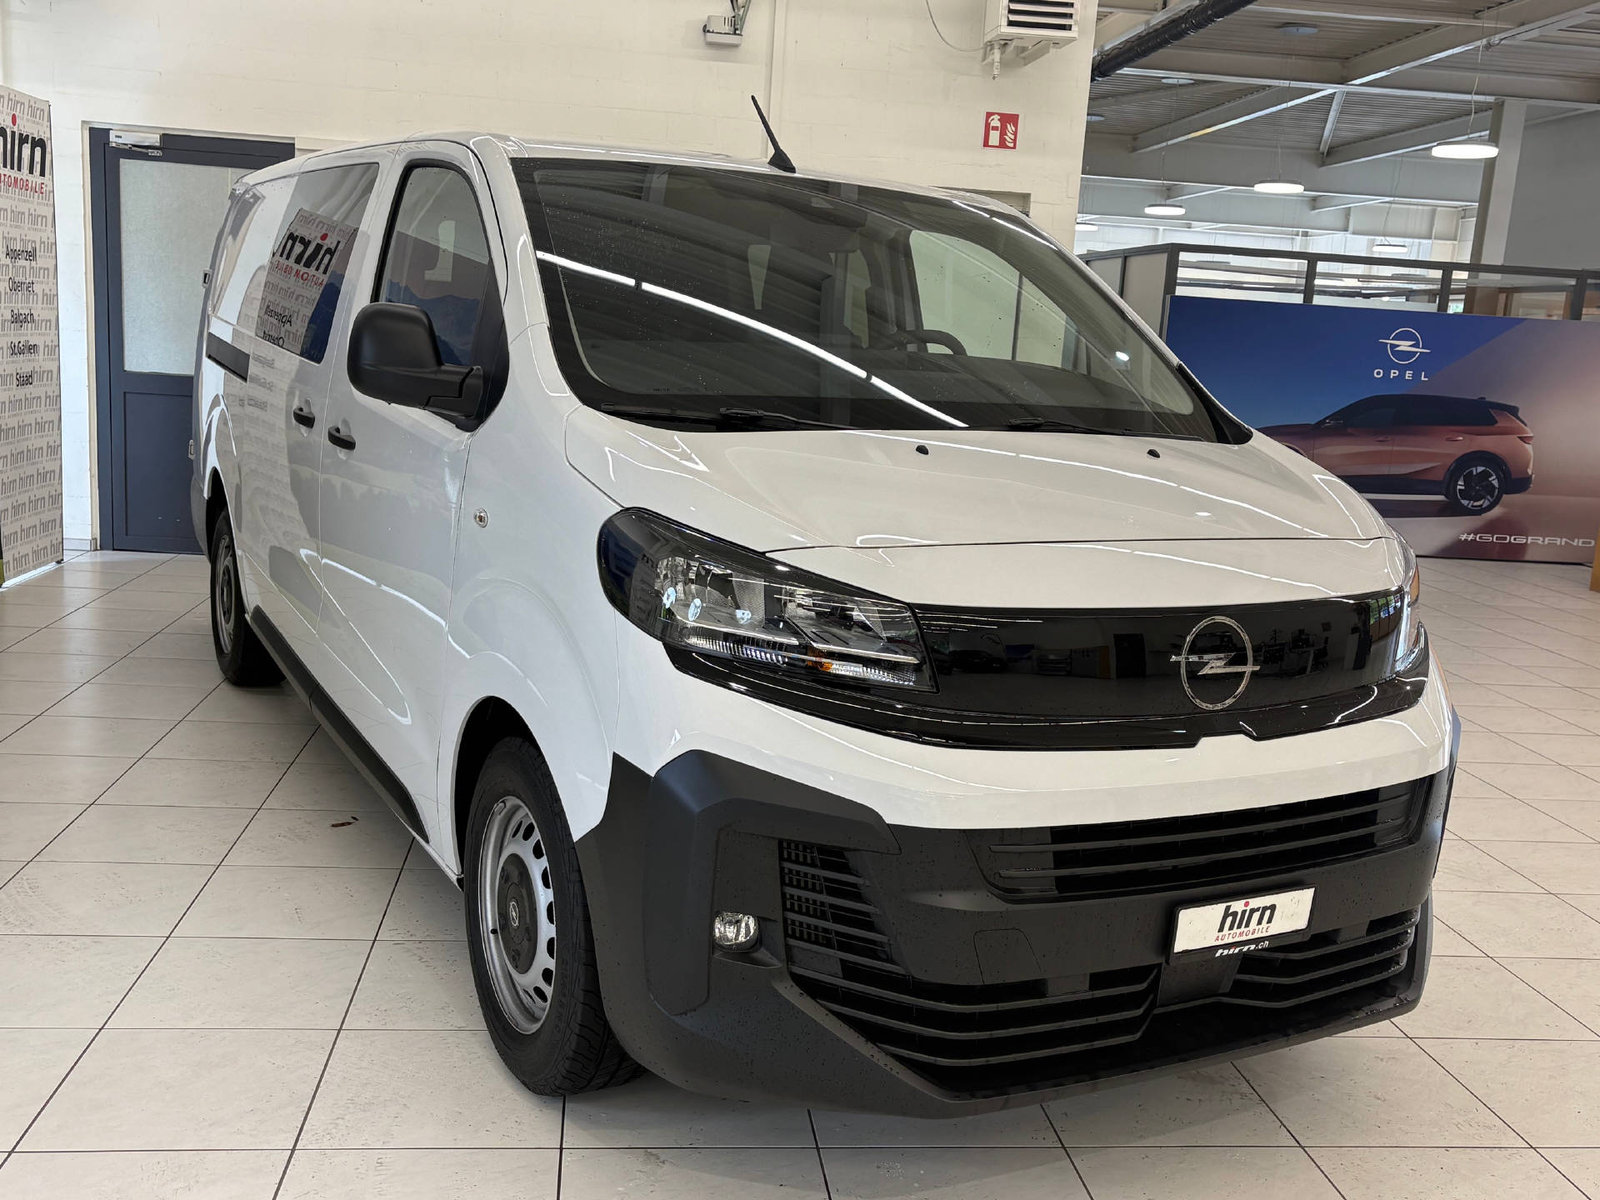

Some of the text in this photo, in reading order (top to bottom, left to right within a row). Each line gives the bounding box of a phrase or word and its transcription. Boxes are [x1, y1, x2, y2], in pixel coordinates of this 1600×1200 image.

[26, 99, 45, 121] hirn
[0, 173, 44, 195] TOMOBILE
[28, 208, 47, 228] hirn
[5, 245, 37, 263] Appenzell
[39, 236, 55, 254] hir
[42, 288, 57, 305] hir
[43, 340, 58, 357] hir
[33, 366, 53, 383] hirn
[1373, 368, 1429, 381] OPEL
[24, 393, 41, 410] hirn
[45, 391, 60, 408] hir
[17, 420, 32, 438] hirn
[35, 417, 54, 434] hirn
[10, 447, 25, 466] hirn
[27, 443, 43, 462] hirn
[46, 440, 61, 457] hir
[1, 475, 17, 495] hirn
[19, 471, 34, 490] hirn
[37, 466, 55, 484] hirn
[11, 499, 26, 520] hirn
[28, 494, 45, 513] hirn
[48, 489, 62, 507] hir
[1459, 533, 1595, 547] #GOGRAND
[12, 551, 30, 571] hirn
[32, 544, 48, 563] hirn
[50, 538, 62, 556] hir
[1217, 900, 1277, 933] hirn
[1214, 925, 1271, 942] AUTOMOBILE
